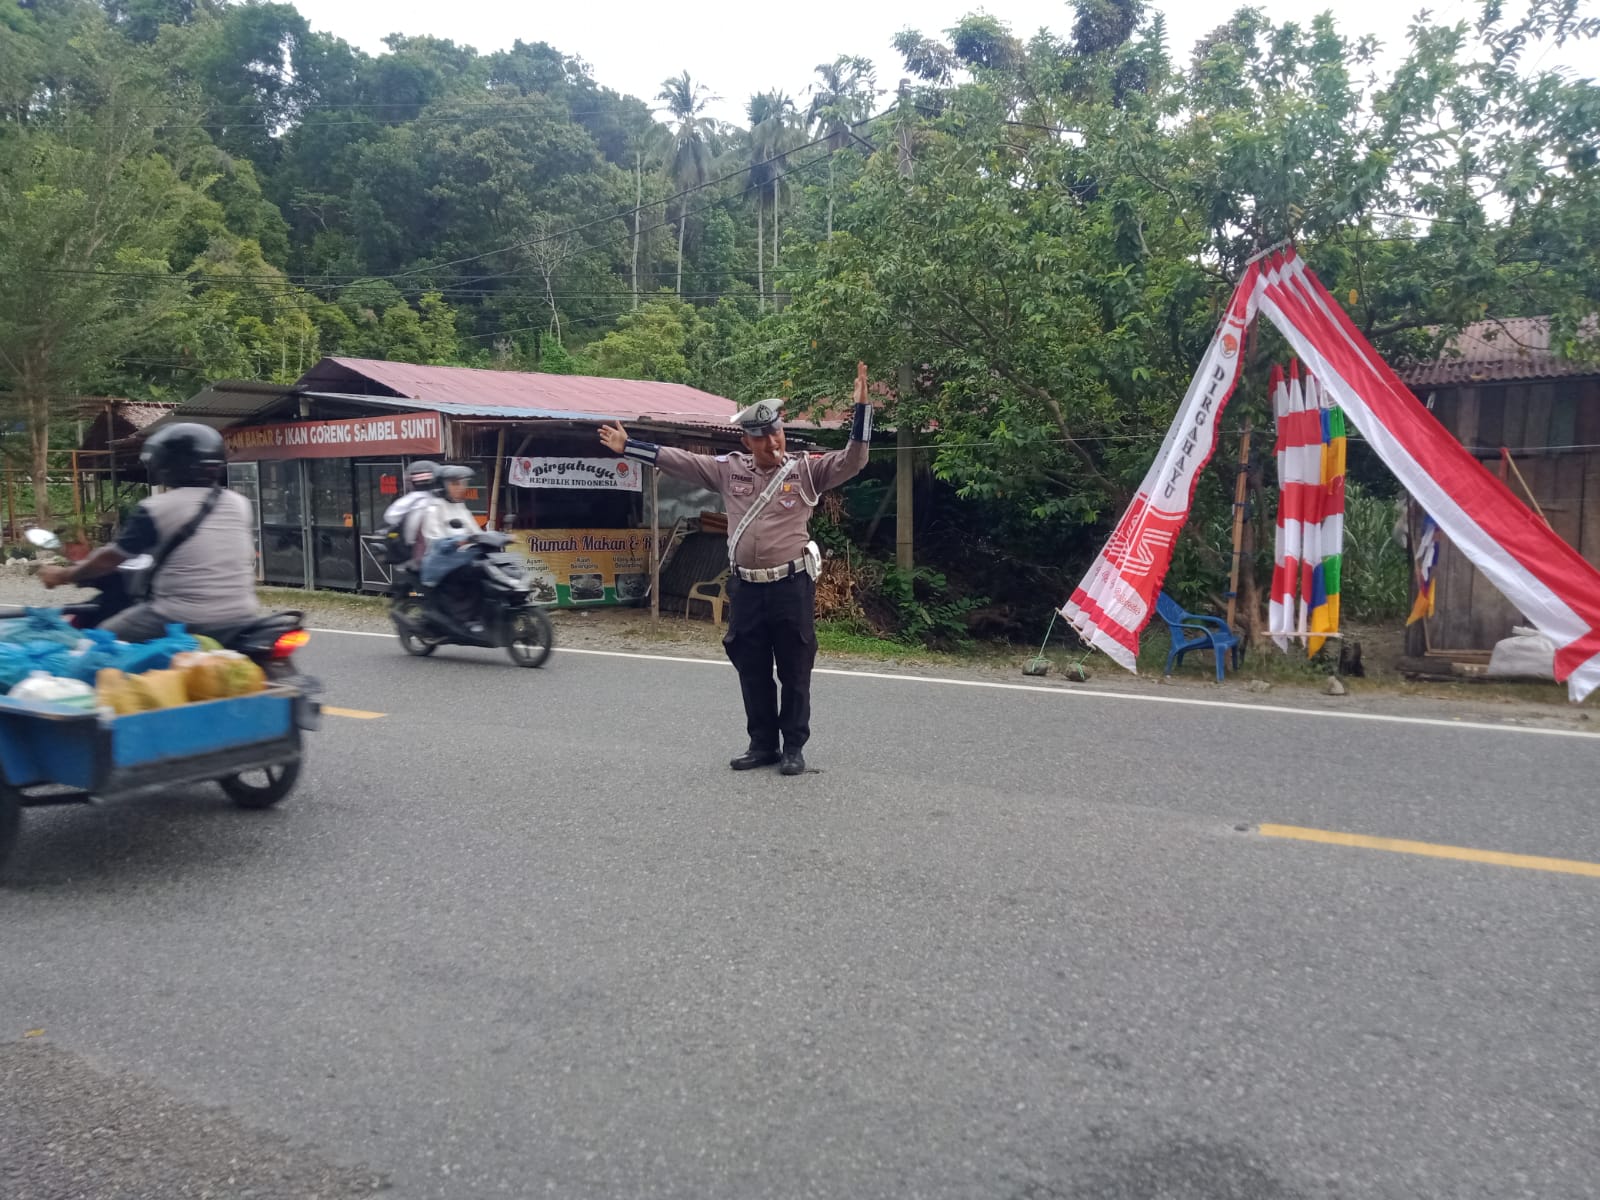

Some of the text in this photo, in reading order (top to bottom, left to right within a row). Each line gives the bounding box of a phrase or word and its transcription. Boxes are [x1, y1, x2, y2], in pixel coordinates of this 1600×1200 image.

[285, 426, 308, 445] IKAN
[309, 423, 351, 444] GORENG
[353, 420, 398, 442] SAMBEL
[400, 418, 436, 440] SUNTI
[1164, 364, 1225, 499] DIRGAHAYU
[532, 460, 615, 479] Dirgahayu
[572, 479, 618, 487] INDONESIA
[528, 535, 577, 553] Rumah
[582, 535, 625, 551] Makan
